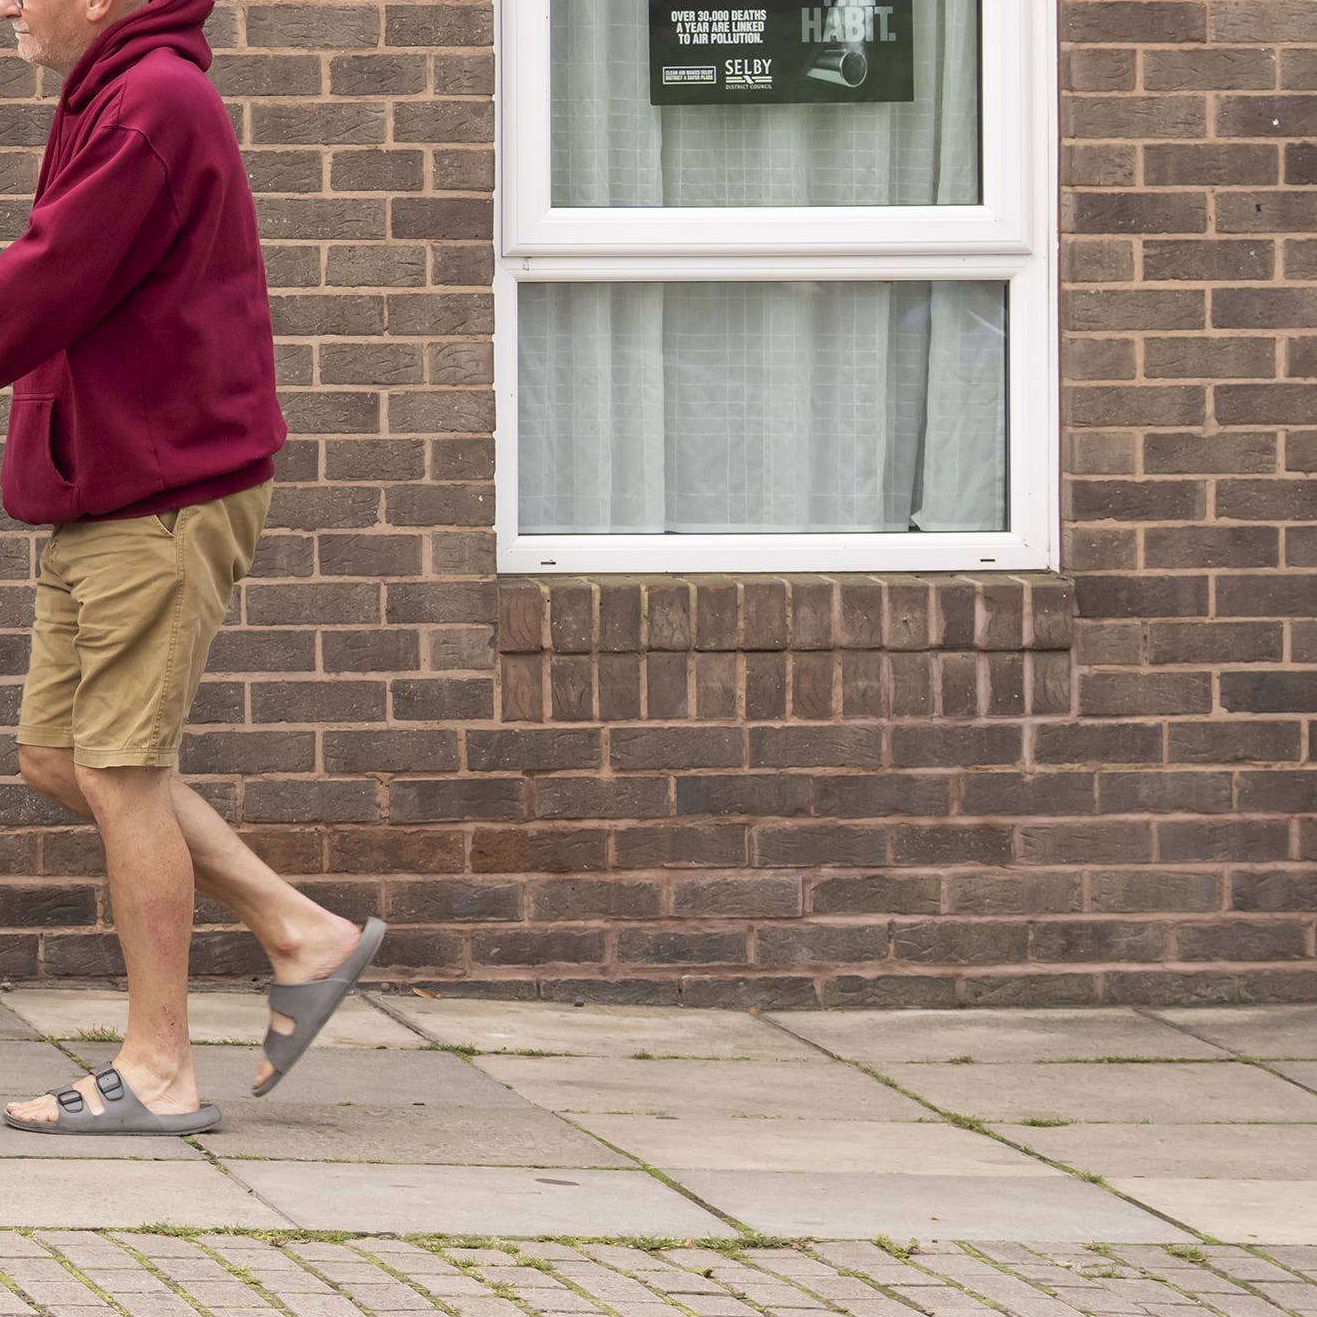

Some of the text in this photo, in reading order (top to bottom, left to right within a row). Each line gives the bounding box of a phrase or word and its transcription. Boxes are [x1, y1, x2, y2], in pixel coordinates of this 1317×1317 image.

[671, 9, 767, 22] OVER 30,000 DEATHS
[676, 21, 765, 33] A YEAR ARE LINKED
[800, 6, 896, 43] HABIT.
[678, 32, 764, 44] TO AIR POLLUTION.
[725, 59, 772, 75] SELBY
